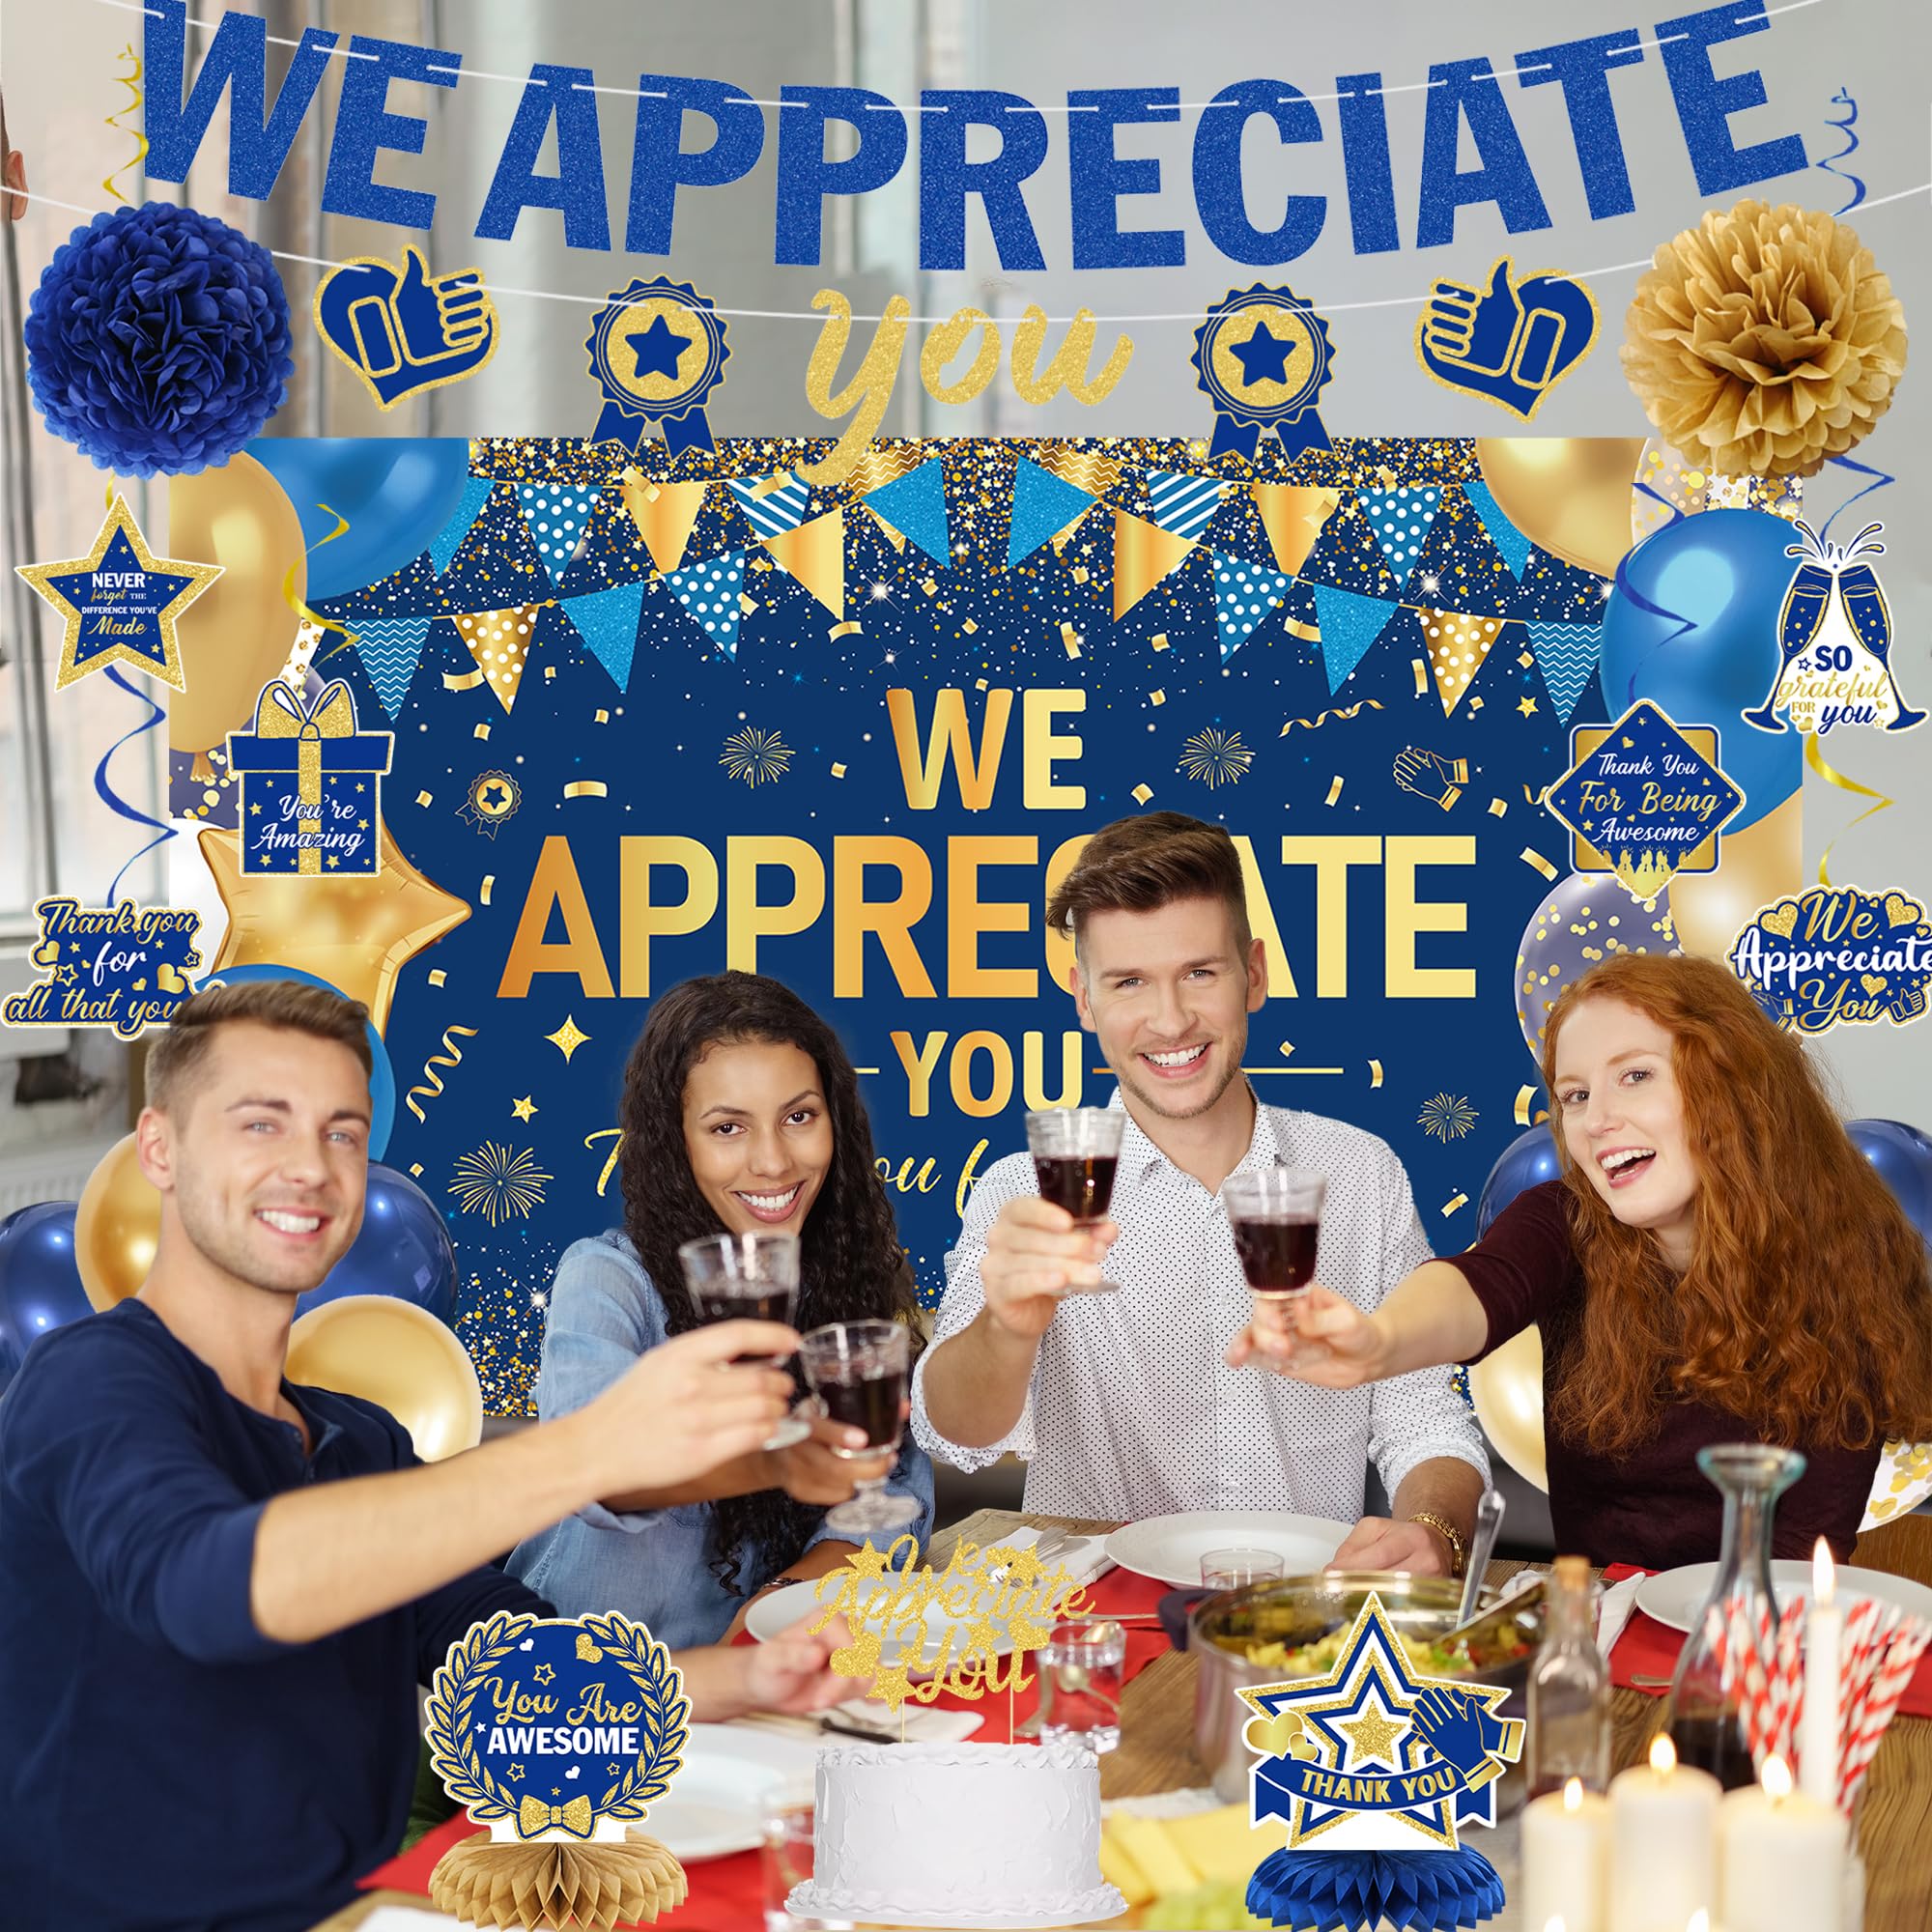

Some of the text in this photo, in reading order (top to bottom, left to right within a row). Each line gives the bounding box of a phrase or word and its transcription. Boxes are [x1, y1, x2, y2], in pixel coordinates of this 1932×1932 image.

[143, 0, 1809, 270] WE APPRECIATE
[794, 288, 1135, 487] you
[90, 587, 128, 607] forget
[92, 572, 146, 588] NEVER
[81, 606, 157, 614] DIFFERENCE YOU'VE
[87, 615, 147, 635] Made
[1814, 644, 1853, 671] SO
[1775, 671, 1888, 708] grateful
[1791, 701, 1877, 734] FOR you
[886, 688, 1087, 811] WE
[1598, 753, 1699, 777] Thank You
[278, 794, 357, 822] You're
[1578, 780, 1722, 822] For Being
[250, 822, 365, 857] Amazing
[1592, 817, 1700, 842] Awesome
[39, 901, 200, 944] Thank you
[1801, 892, 1879, 943] We
[93, 941, 147, 987] for
[8, 988, 52, 1020] all
[61, 987, 124, 1020] that
[1799, 978, 1884, 1030] You
[889, 1030, 1082, 1118] YOU
[886, 1533, 981, 1604] We
[807, 1562, 1096, 1638] Appreciate
[896, 1619, 1036, 1703] You
[484, 1676, 643, 1726] You Are
[487, 1726, 639, 1754] AWESOME
[1301, 1766, 1457, 1804] THANK YOU
